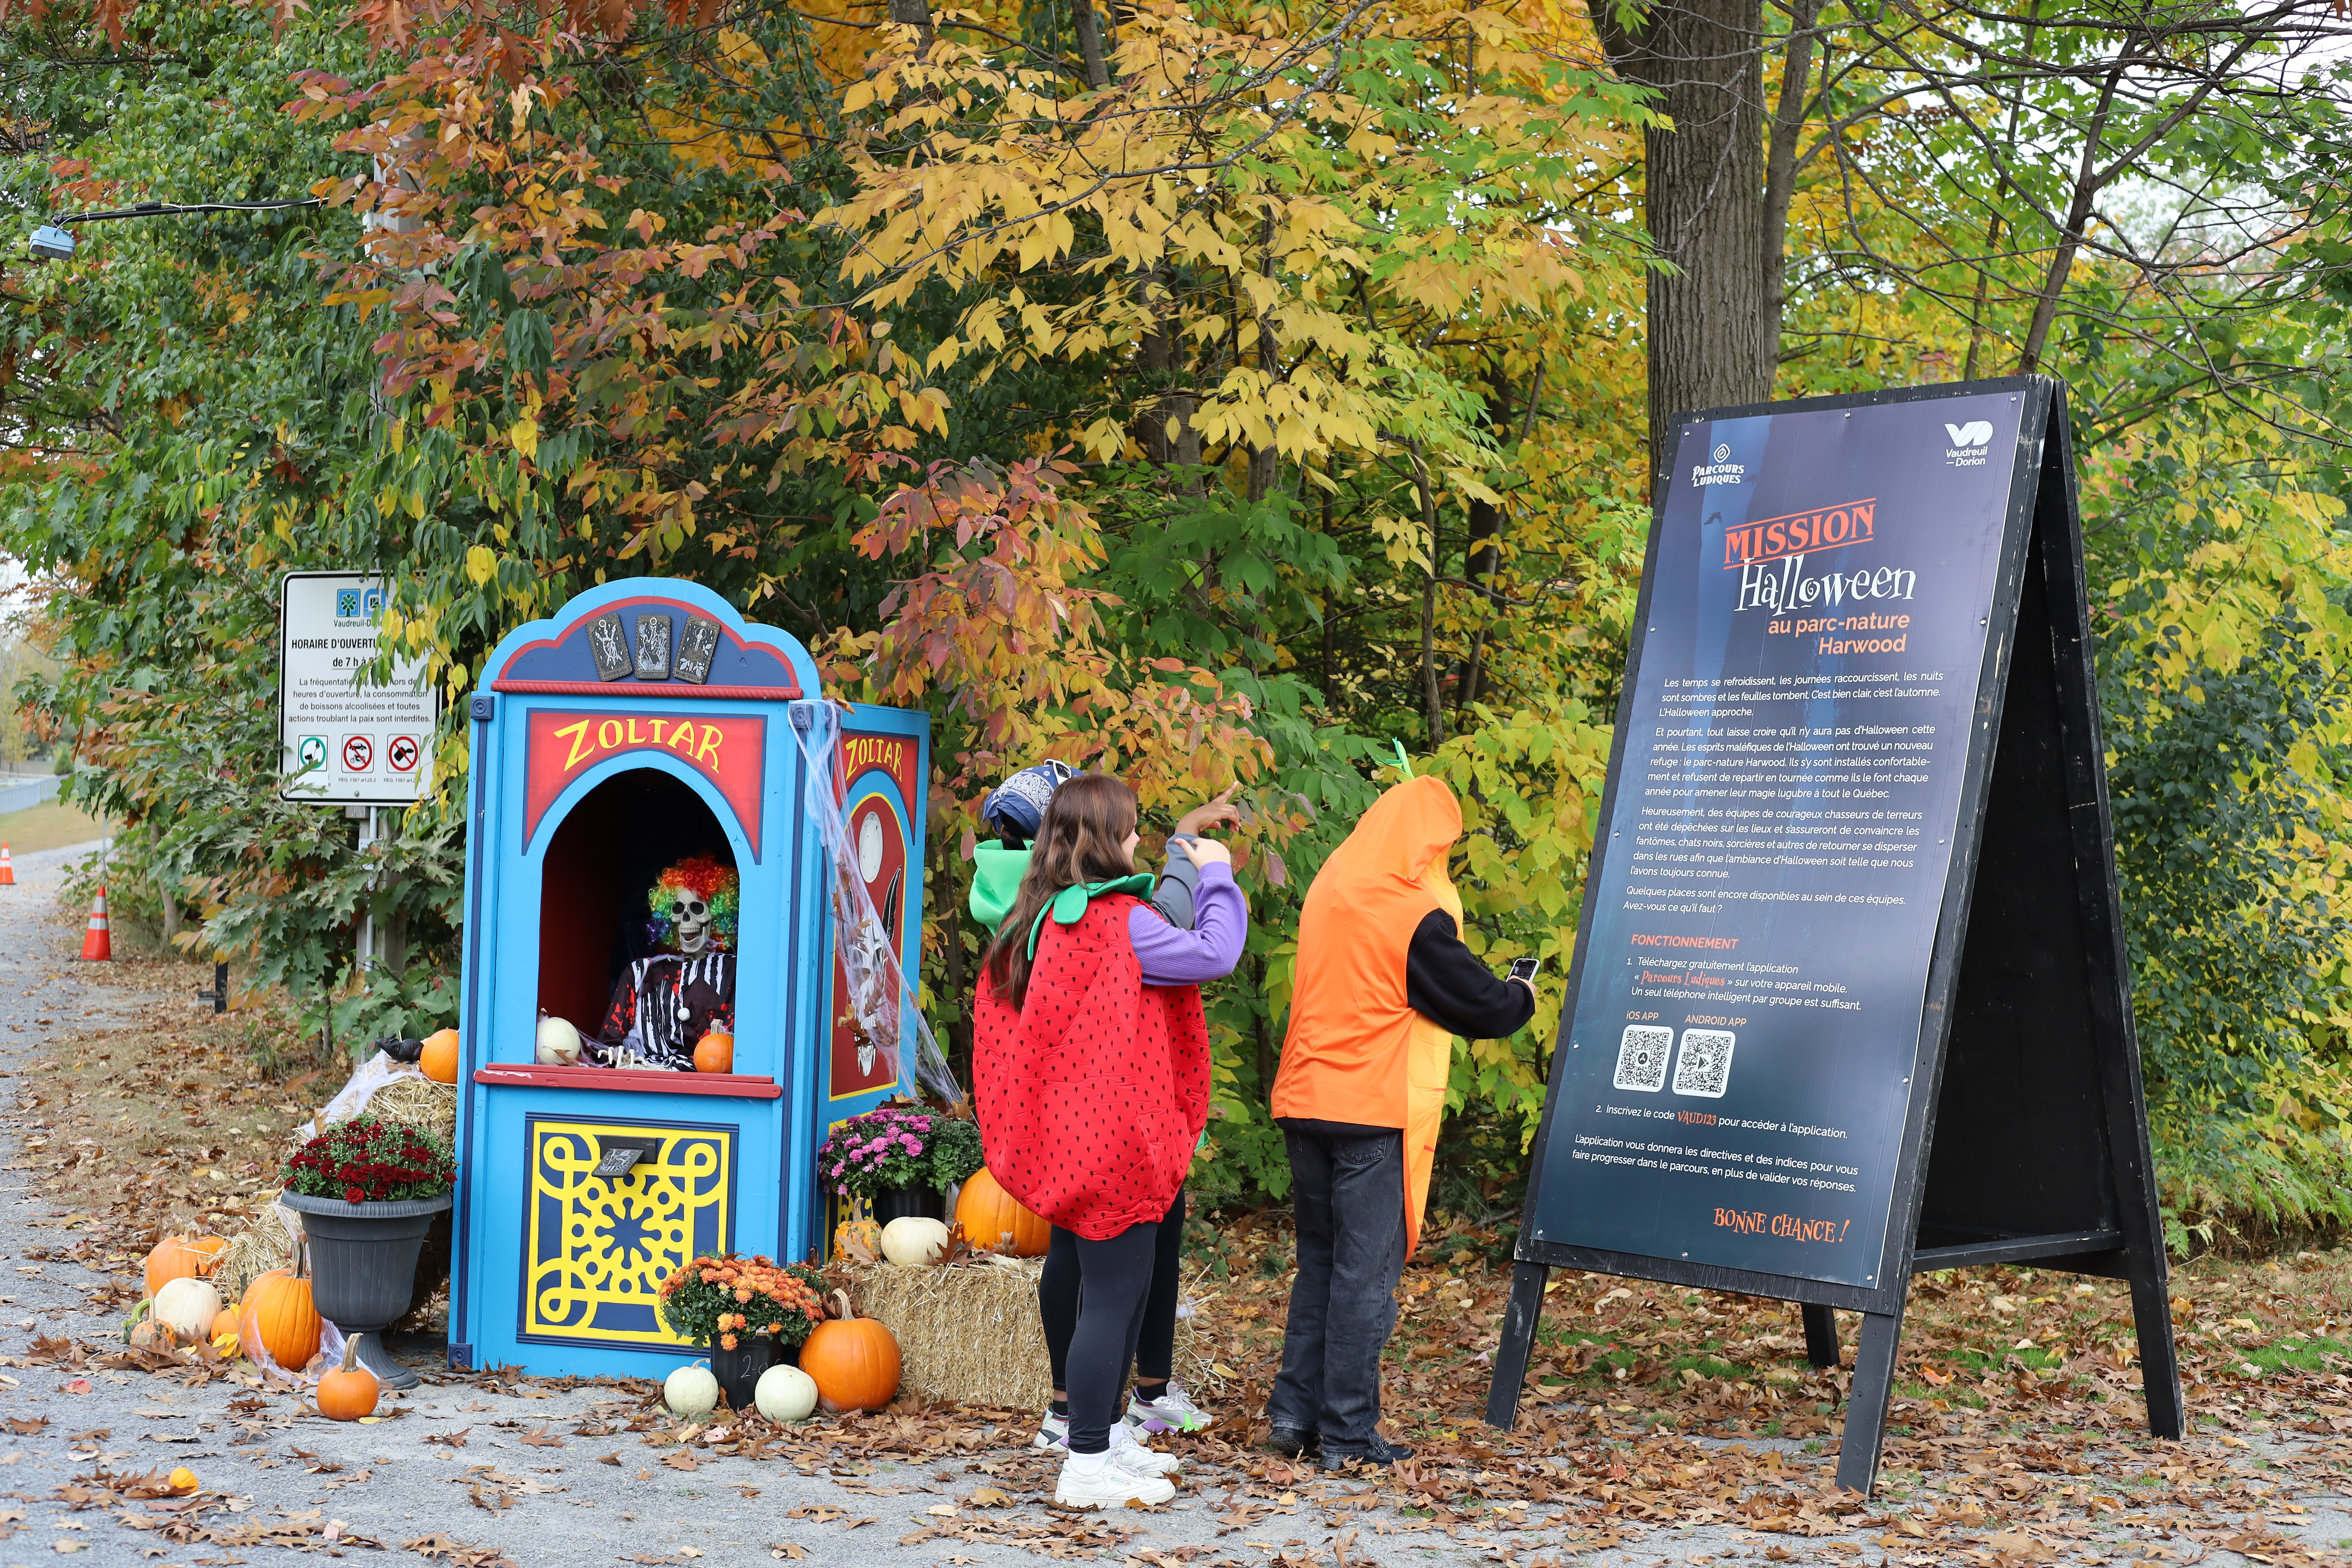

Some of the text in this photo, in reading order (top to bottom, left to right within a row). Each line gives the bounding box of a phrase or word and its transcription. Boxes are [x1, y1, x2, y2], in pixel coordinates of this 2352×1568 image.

[1946, 446, 1988, 458] Vaudreuil
[1691, 464, 1744, 481] PARCOURS
[1693, 475, 1741, 487] LUDIQUES
[1724, 504, 1876, 564] MISSION
[1734, 553, 1916, 617] Halloween
[1768, 612, 1910, 638] au parc-nature
[292, 639, 328, 649] HORAIRE
[1818, 633, 1907, 655] Harwood
[333, 657, 343, 666] de
[346, 657, 350, 666] 7
[354, 657, 358, 666] h
[1664, 678, 1680, 687] Les
[1682, 678, 1709, 689] temps
[1723, 675, 1776, 686] refroidissent,
[1779, 675, 1792, 685] les
[1793, 674, 1831, 686] journées
[1834, 672, 1900, 683] raccourcissent,
[1903, 671, 1917, 681] les
[1920, 671, 1944, 681] nuits
[319, 690, 362, 699] d'ouverture,
[1661, 687, 1940, 702] sont sombres et les feuilles tombent. C'est bien clair, c'est l'automne.
[1658, 706, 1753, 719] L'Halloween approche.
[553, 719, 723, 774] ZOLTAR
[1652, 741, 1680, 751] année.
[1681, 742, 1696, 751] Les
[1697, 742, 1725, 753] esprits
[1725, 742, 1772, 753] maléfiques
[1773, 741, 1785, 751] de
[1785, 741, 1834, 751] l'Halloween
[1835, 741, 1850, 751] ont
[1851, 740, 1880, 750] trouvé
[1894, 742, 1933, 750] nouveau
[845, 737, 902, 782] ZOLTAR
[1641, 806, 1923, 821] Heureusement, des équipes de courageux chasseurs de terreurs
[1630, 865, 1730, 878] l'avons toujours connue.
[1626, 885, 1667, 898] Quelques
[1667, 887, 1696, 899] places
[1697, 889, 1717, 898] sont
[1749, 890, 1800, 902] disponibles
[1813, 892, 1833, 902] sein
[1834, 893, 1847, 902] de
[1866, 893, 1905, 906] équipes.
[1631, 934, 1739, 949] FONCTIONNEMENT
[1637, 956, 1688, 970] Téléchargez
[1688, 960, 1745, 971] gratuitement
[1746, 962, 1798, 975] l'application
[1640, 970, 1682, 985] Parcours
[1683, 971, 1725, 988] Ludiques
[1750, 978, 1773, 988] votre
[1774, 981, 1812, 992] appareil
[1813, 982, 1847, 993] mobile.
[1631, 986, 1861, 1011] Un seul téléphone intelligent par groupe est suffisant.
[1626, 1010, 1659, 1021] iOS APP
[1684, 1014, 1747, 1027] ANDROID APP
[1595, 1104, 1848, 1139] 2. Inscrivez le code VAUD123 pour accéder à l'application.
[1574, 1133, 1859, 1175] L'application vous donnera les directives et des indices pour vous
[1712, 1207, 1767, 1234] BONNE
[1771, 1213, 1836, 1243] CHANCE
